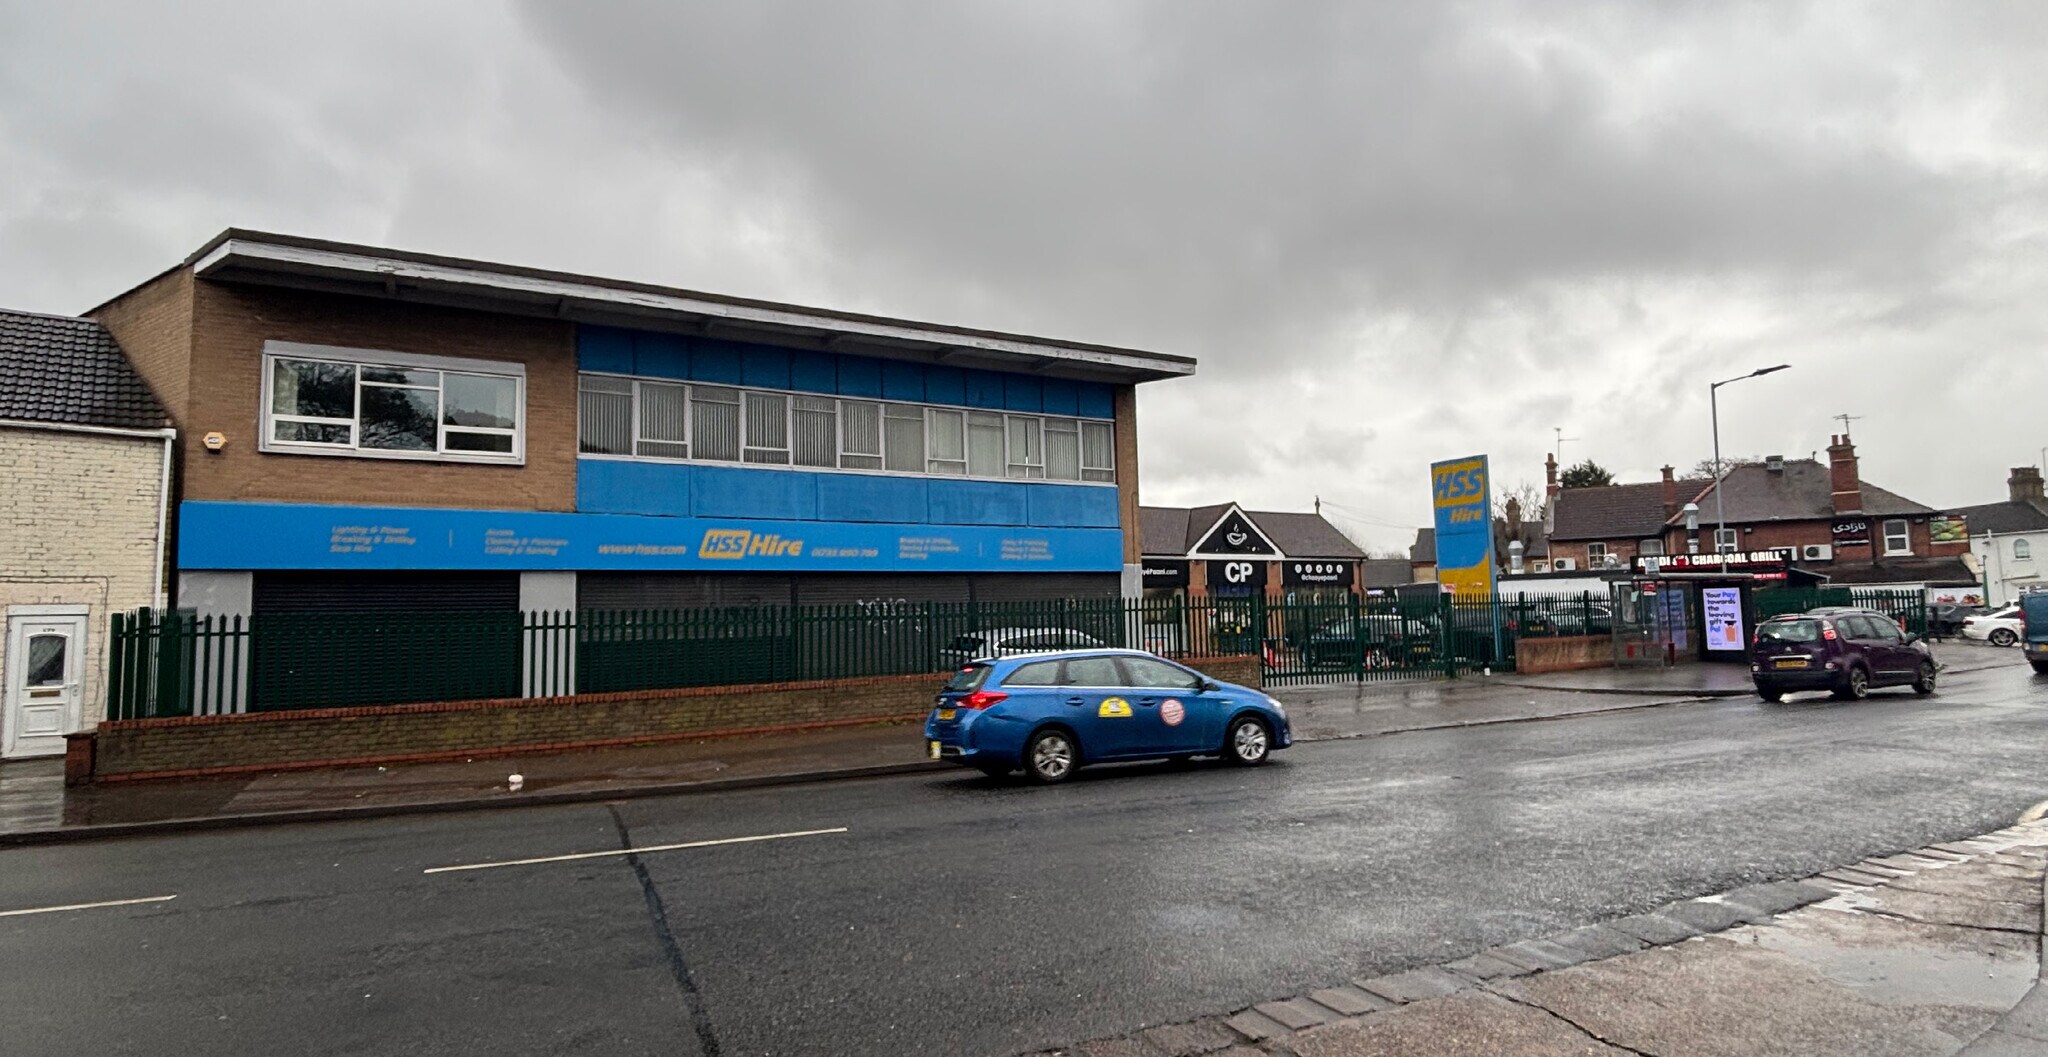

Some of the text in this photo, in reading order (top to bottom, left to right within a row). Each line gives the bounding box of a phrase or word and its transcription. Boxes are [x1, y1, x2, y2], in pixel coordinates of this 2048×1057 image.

[1434, 468, 1482, 499] HSS
[1450, 508, 1482, 523] Hire
[598, 544, 687, 555] www.hss.com
[705, 534, 804, 556] HSS Hire
[1637, 551, 1782, 568] ADI CHARCOAL GRILL
[1225, 562, 1254, 584] CP
[1722, 591, 1736, 599] Pay
